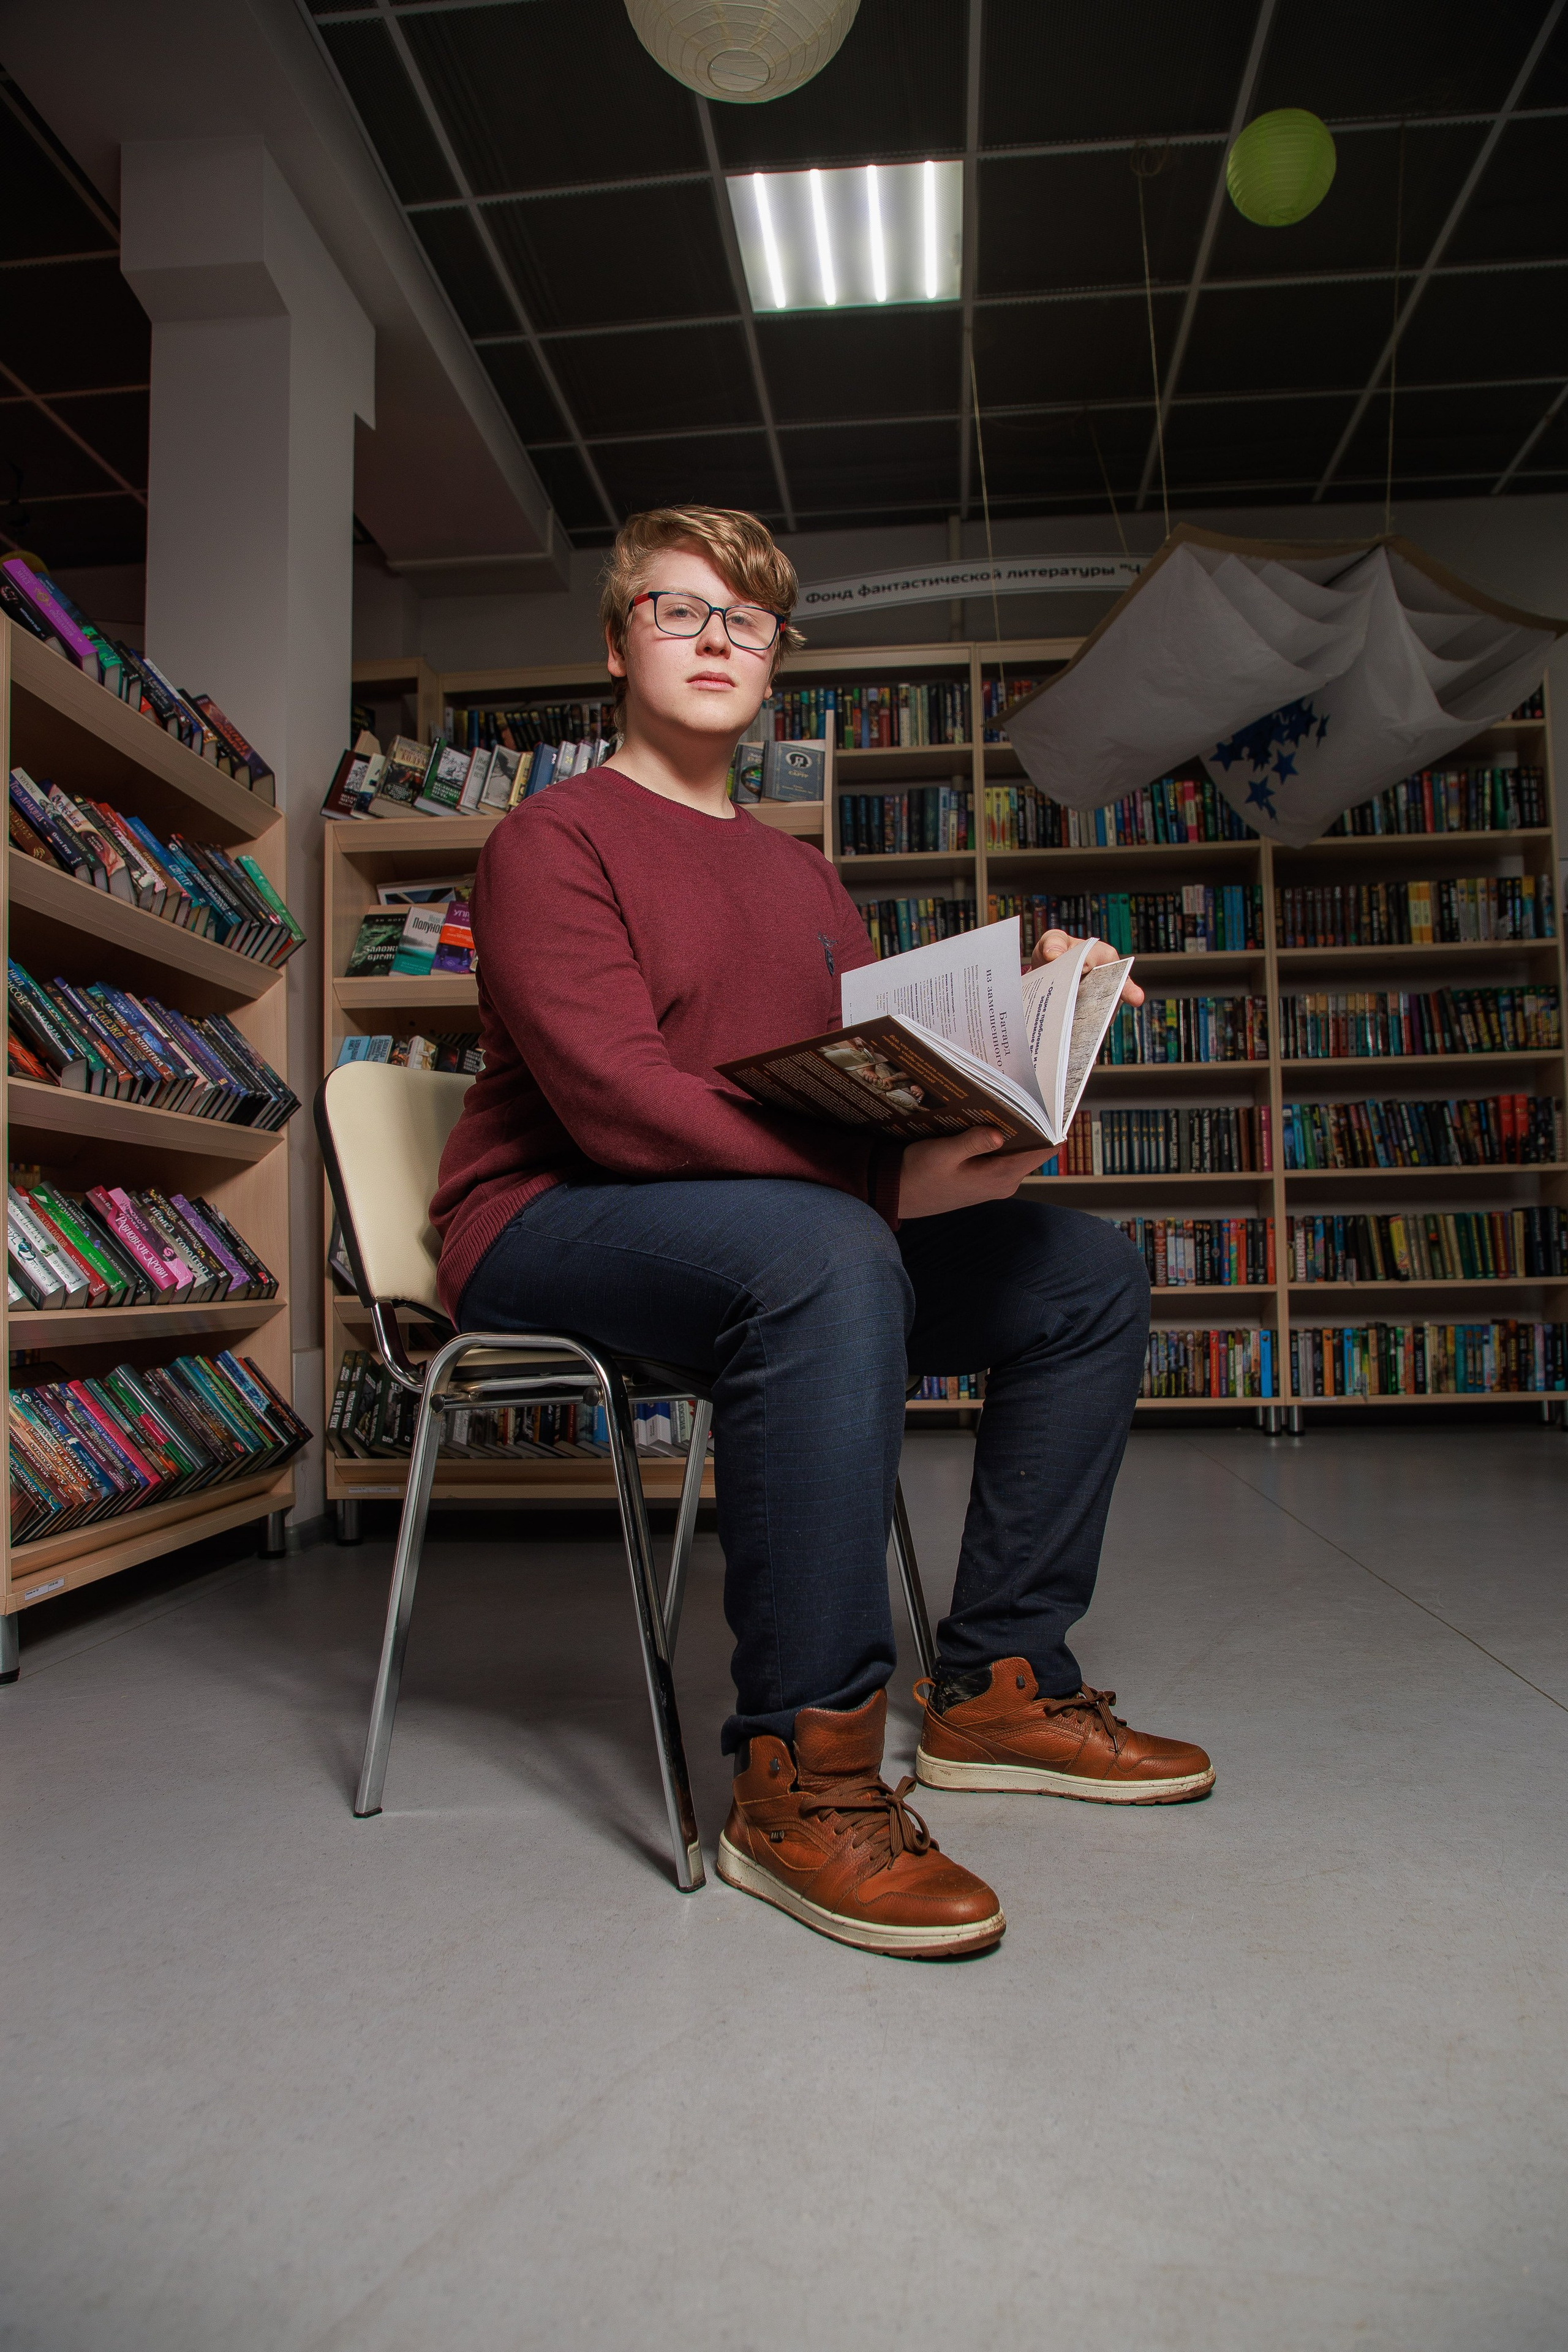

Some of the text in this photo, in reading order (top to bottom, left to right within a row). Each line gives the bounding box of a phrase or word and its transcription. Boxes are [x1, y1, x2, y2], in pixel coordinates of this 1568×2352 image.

[806, 589, 854, 605] Фонд
[858, 570, 1001, 598] фантастической
[1006, 565, 1115, 580] литературы
[985, 969, 1003, 1067] из замешенного
[1042, 986, 1053, 1012] Общие
[95, 1008, 125, 1041] СКАЗКА
[997, 1011, 1012, 1056] Батард
[1030, 994, 1044, 1044] задаваемые
[1034, 1013, 1045, 1055] проблемы
[20, 1213, 45, 1245] ПЕПЛА
[111, 1211, 169, 1283] РАВНОВЕСИЕ КРОВИ
[29, 1259, 47, 1283] ВУЛЬФ
[52, 1257, 70, 1281] ВУЛЬФ
[34, 1395, 65, 1434] РОБЕРТС
